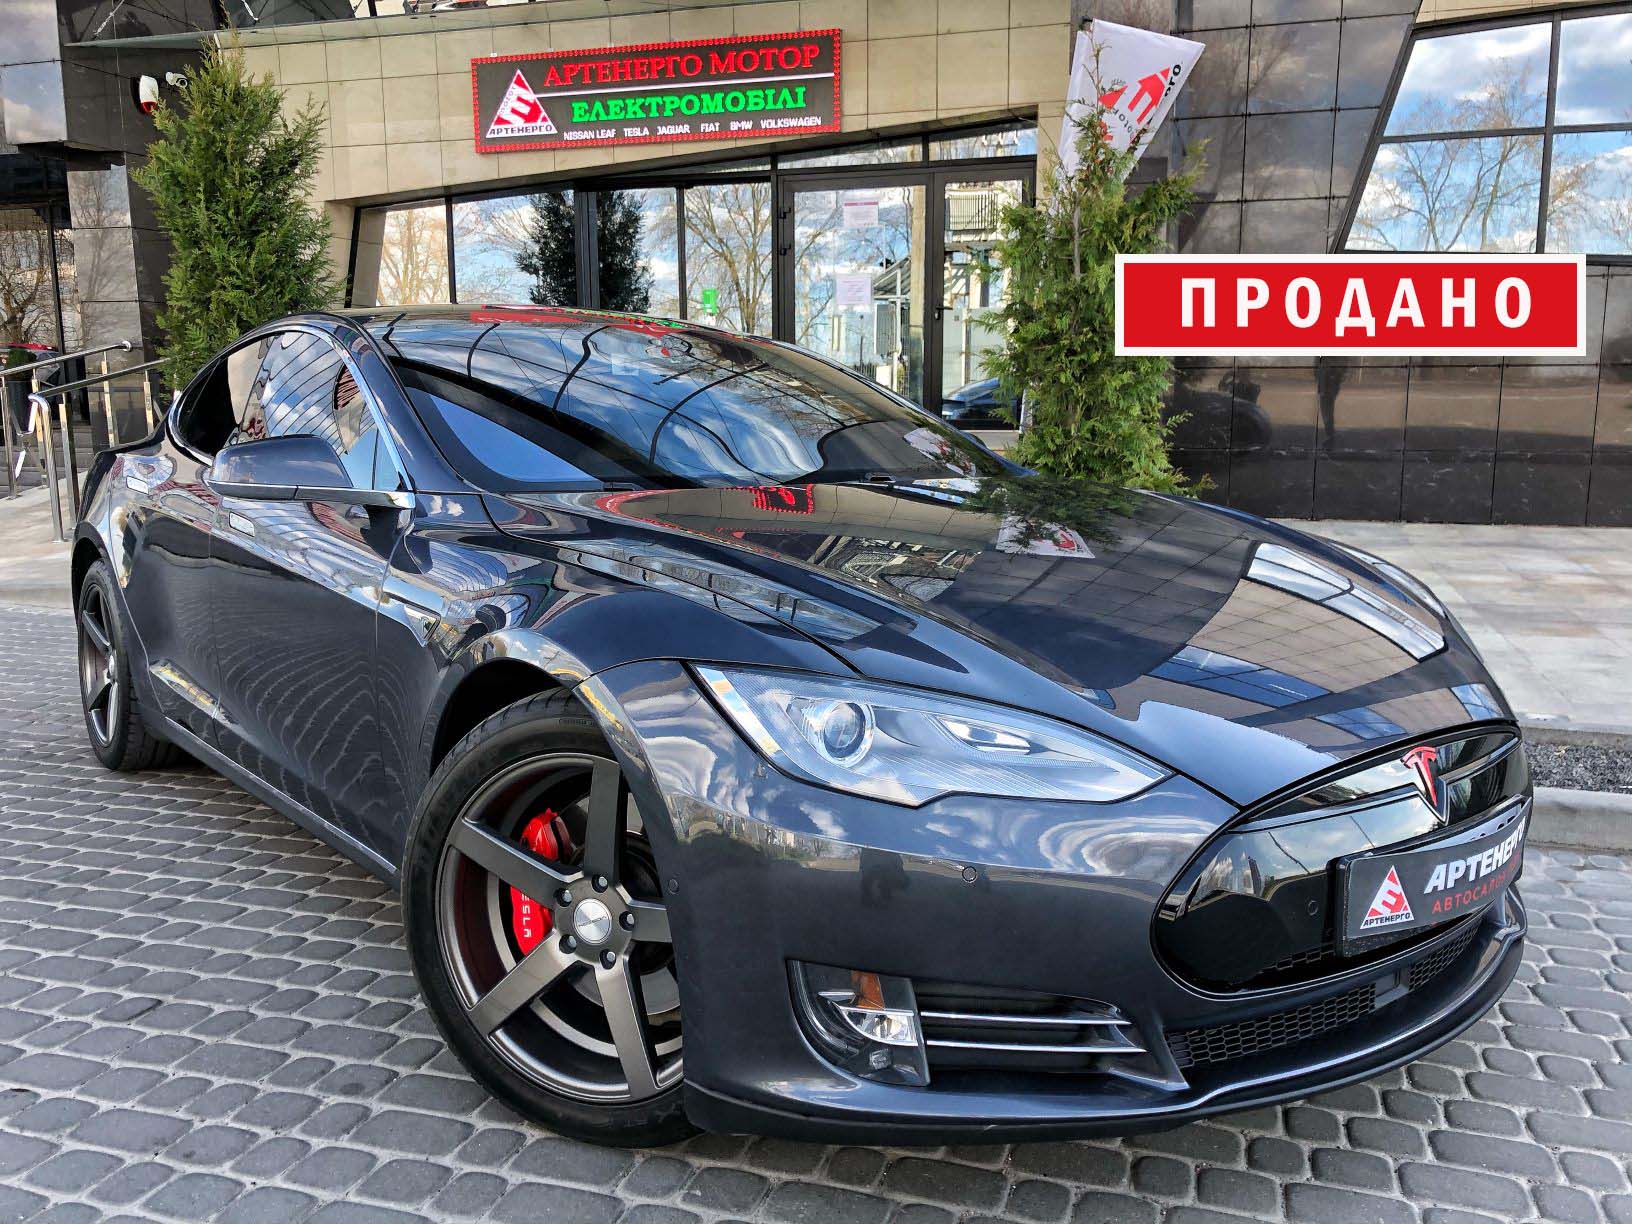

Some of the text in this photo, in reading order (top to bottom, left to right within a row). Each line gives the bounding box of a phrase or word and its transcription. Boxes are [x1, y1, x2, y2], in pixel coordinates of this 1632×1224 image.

[543, 43, 820, 87] АРТЕНЕРГО МОТОР
[571, 85, 807, 123] ЕЛЕКТРОМОБІЛІ
[489, 124, 553, 136] АРТЕНЕРГО
[563, 116, 822, 141] NISSAN LEAF TESLA JAGUAR FIAT BMW VOLKSWAGEN
[1363, 911, 1412, 928] АРТЕНЕРГО
